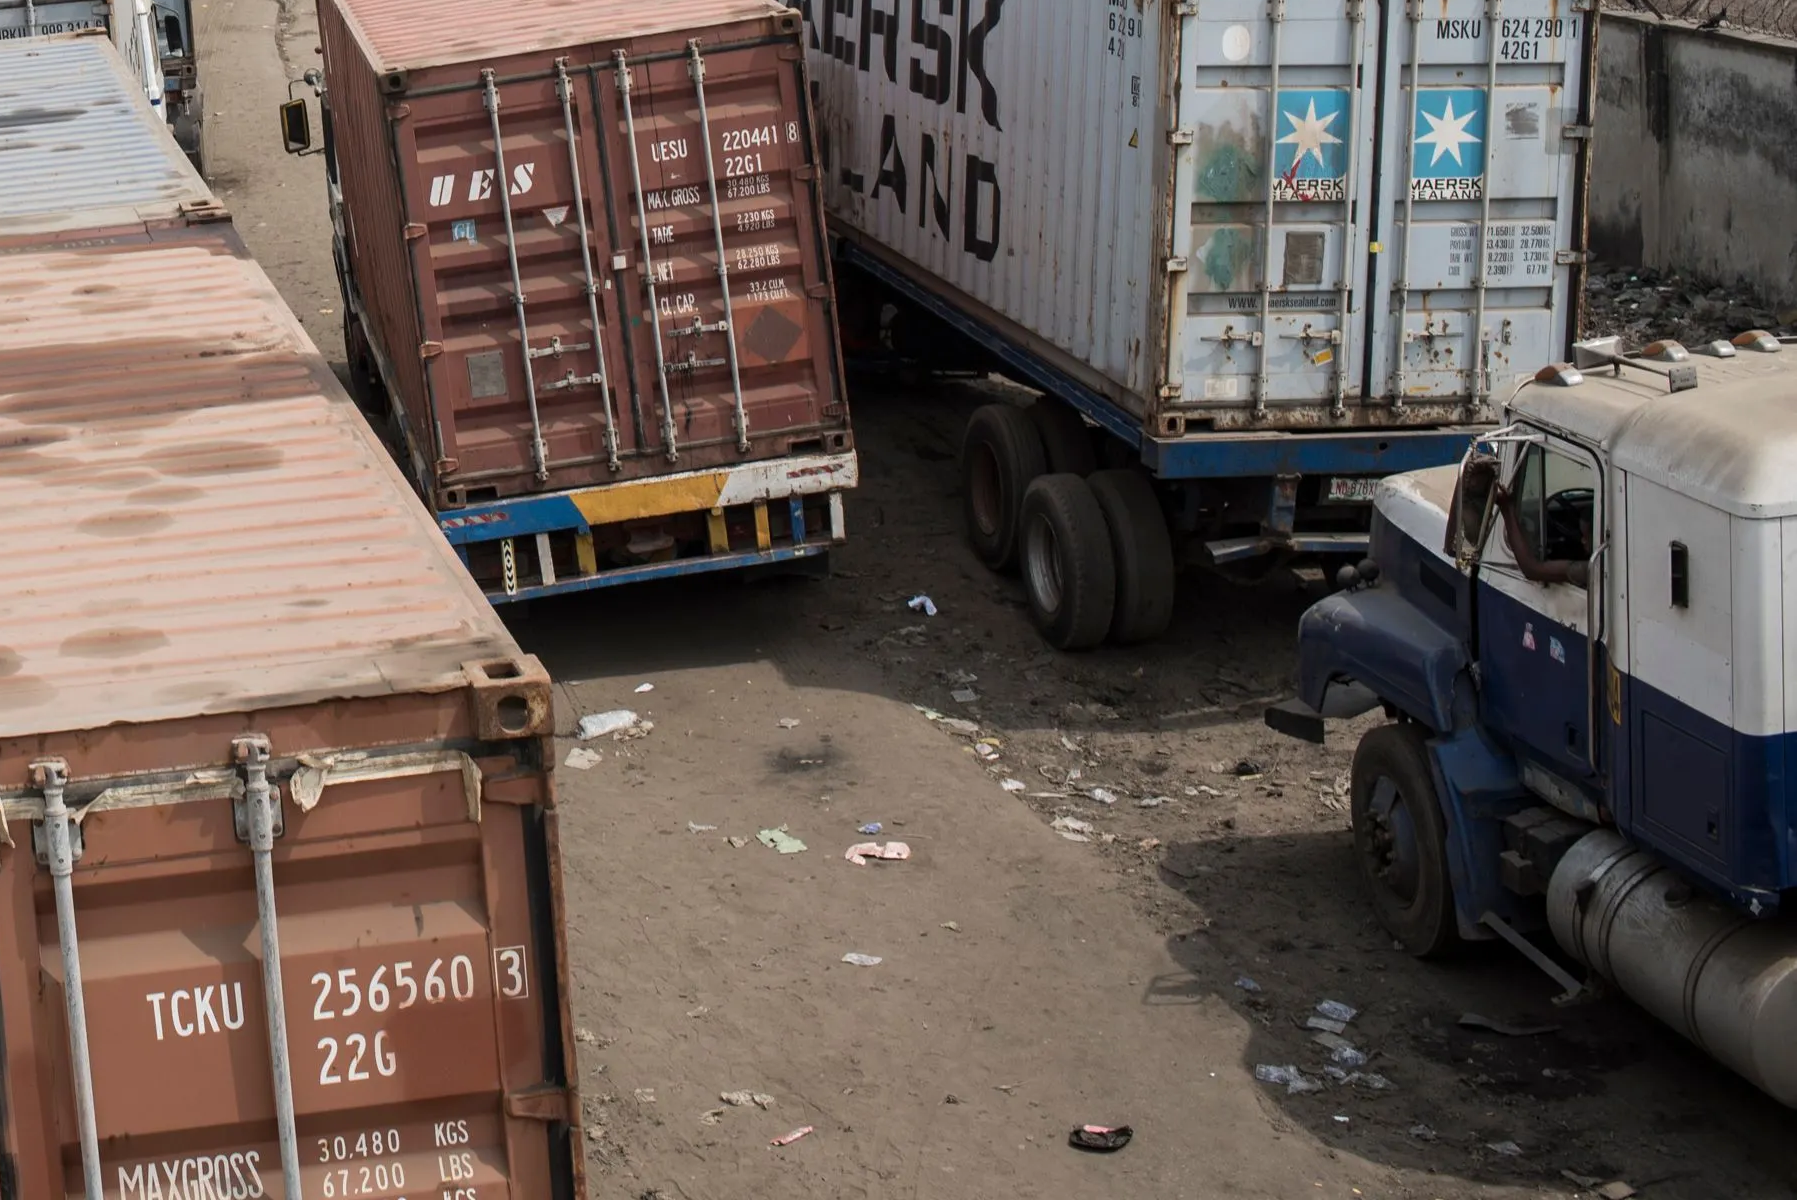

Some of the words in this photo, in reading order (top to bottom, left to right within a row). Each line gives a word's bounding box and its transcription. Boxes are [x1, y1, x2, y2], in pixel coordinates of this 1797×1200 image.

[1437, 19, 1481, 39] MSKU
[722, 125, 777, 151] 220441
[789, 123, 797, 141] 8
[651, 138, 688, 162] UESU
[725, 153, 763, 177] 22G1
[727, 177, 754, 188] 30.480
[756, 174, 769, 183] KGS
[727, 186, 755, 198] 67.200
[757, 183, 770, 194] LBS
[1273, 178, 1343, 191] MAERSK
[1412, 177, 1482, 191] MAERSK
[1412, 189, 1482, 200] SEALAND
[737, 212, 759, 224] 2.230
[761, 209, 775, 220] KGS
[652, 225, 674, 244] TARE
[737, 221, 760, 232] 4.920
[762, 219, 775, 228] LBS
[736, 246, 763, 259] 28.250
[765, 244, 779, 256] KGS
[656, 261, 675, 282] NET
[737, 258, 765, 270] 62.280
[766, 255, 780, 266] LBS
[749, 282, 767, 293] 33.2
[146, 981, 245, 1041] TCKU
[310, 954, 475, 1021] 256560
[500, 949, 522, 997] 3
[316, 1029, 398, 1086] 22G
[433, 1119, 469, 1147] KGS
[118, 1151, 264, 1200] MAXGROSS
[438, 1152, 474, 1182] LBS
